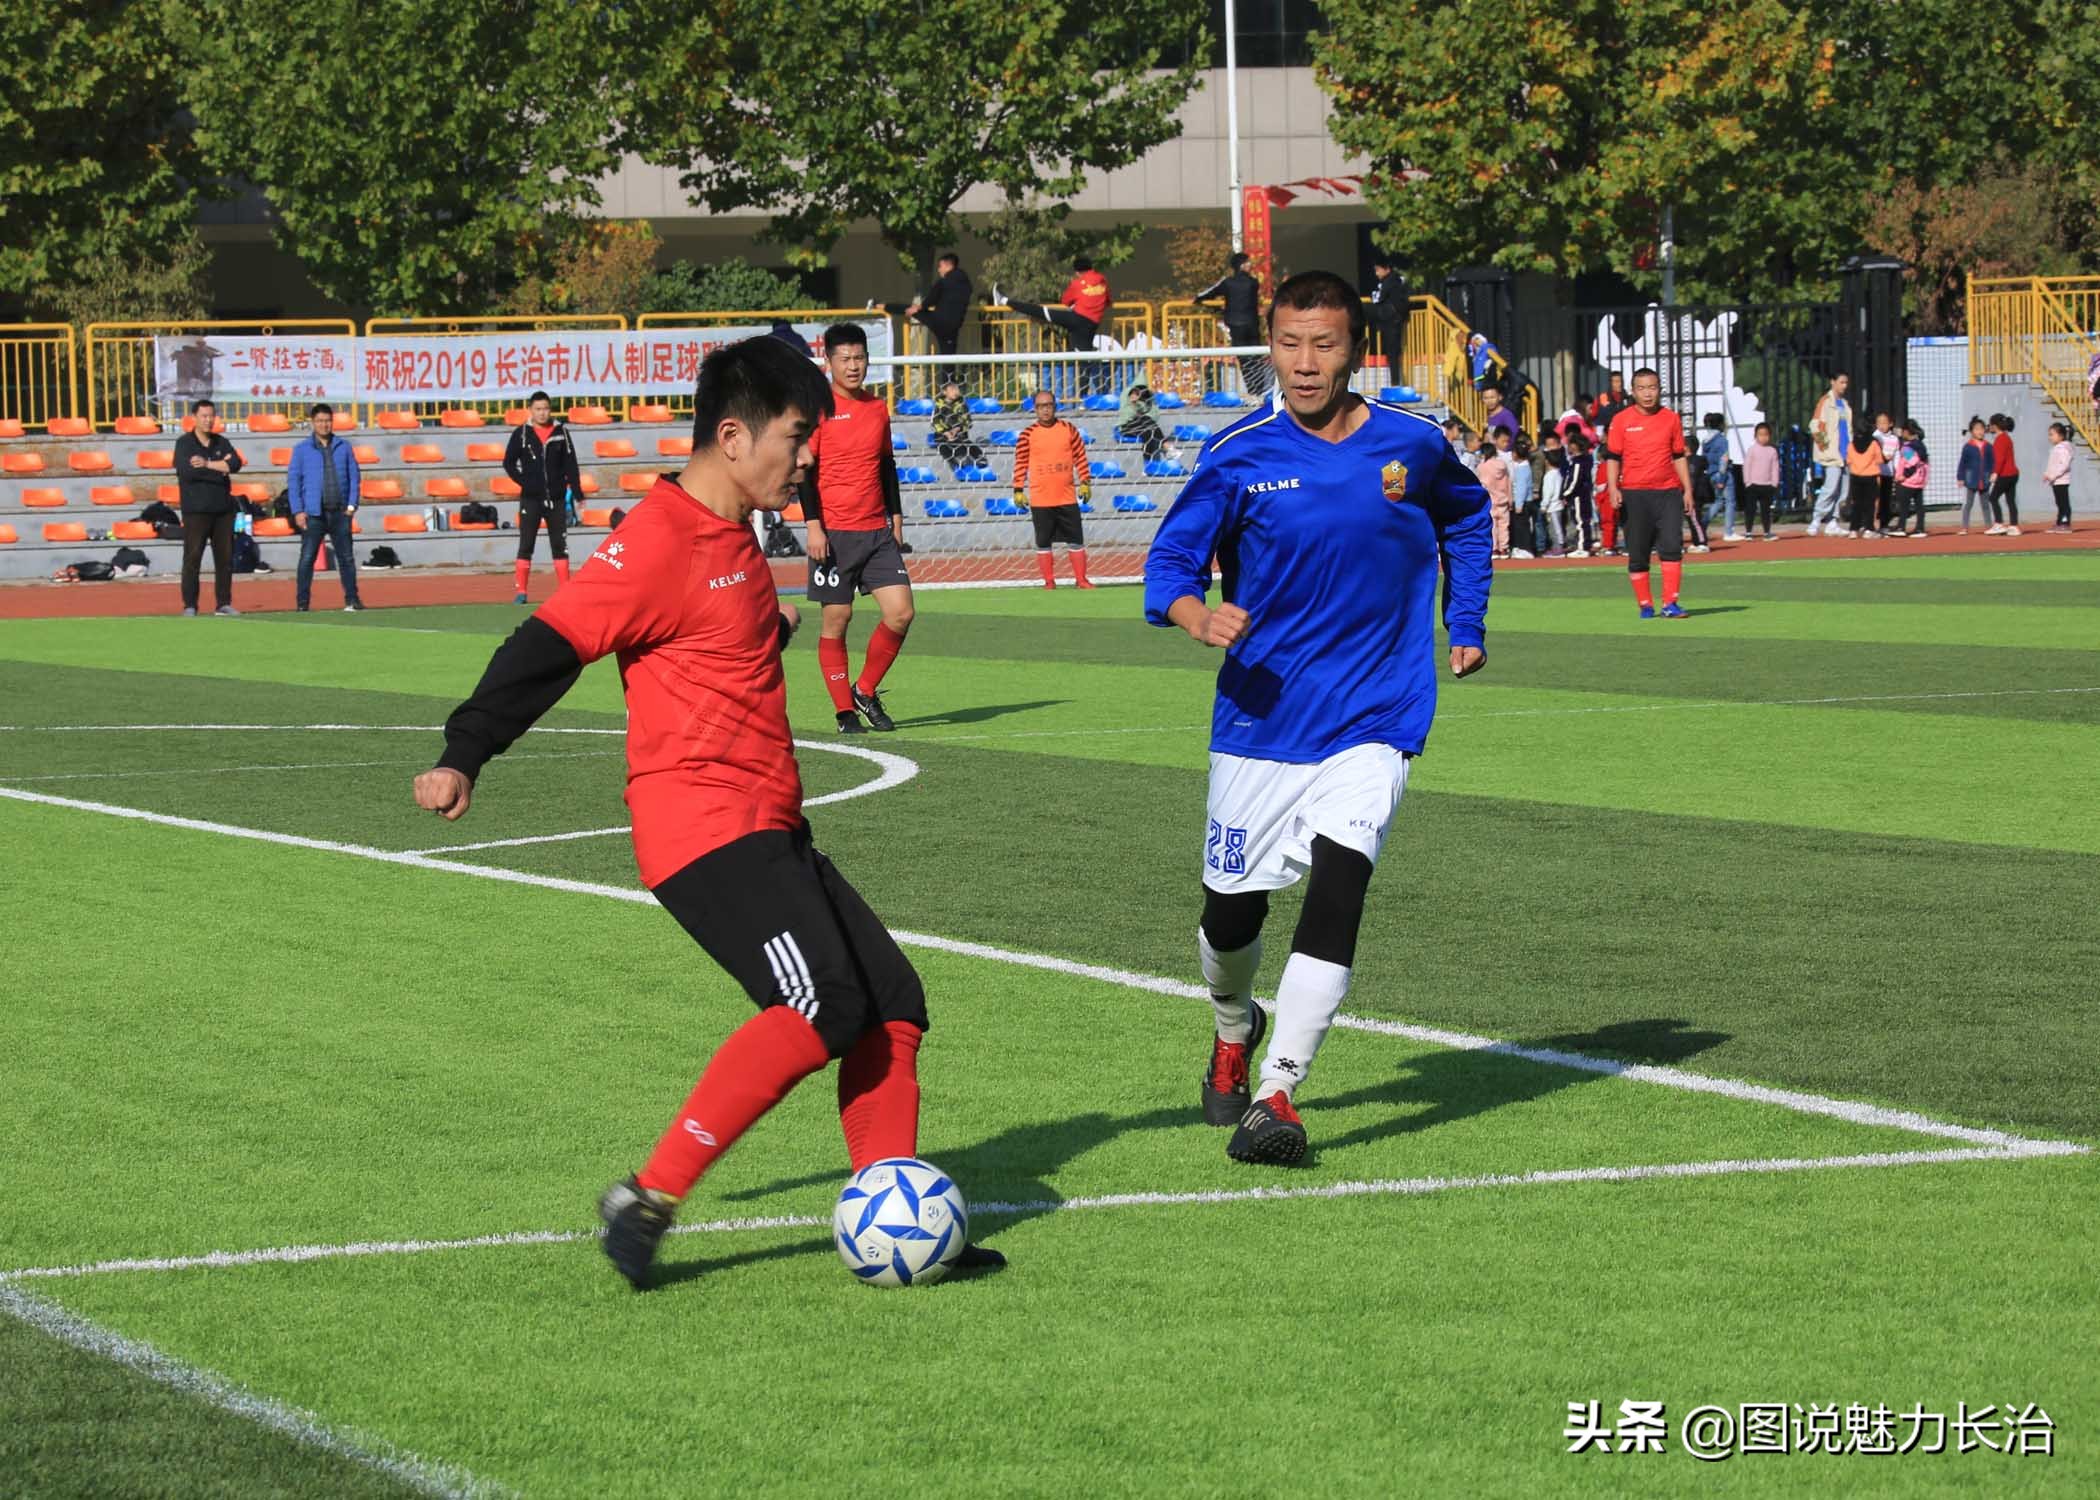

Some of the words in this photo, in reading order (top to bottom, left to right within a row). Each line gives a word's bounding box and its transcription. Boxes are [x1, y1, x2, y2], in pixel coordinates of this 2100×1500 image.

[1247, 478, 1301, 494] KELME
[593, 551, 624, 570] KELME
[709, 571, 747, 590] KELME
[814, 566, 840, 588] 66
[1207, 817, 1248, 875] 28
